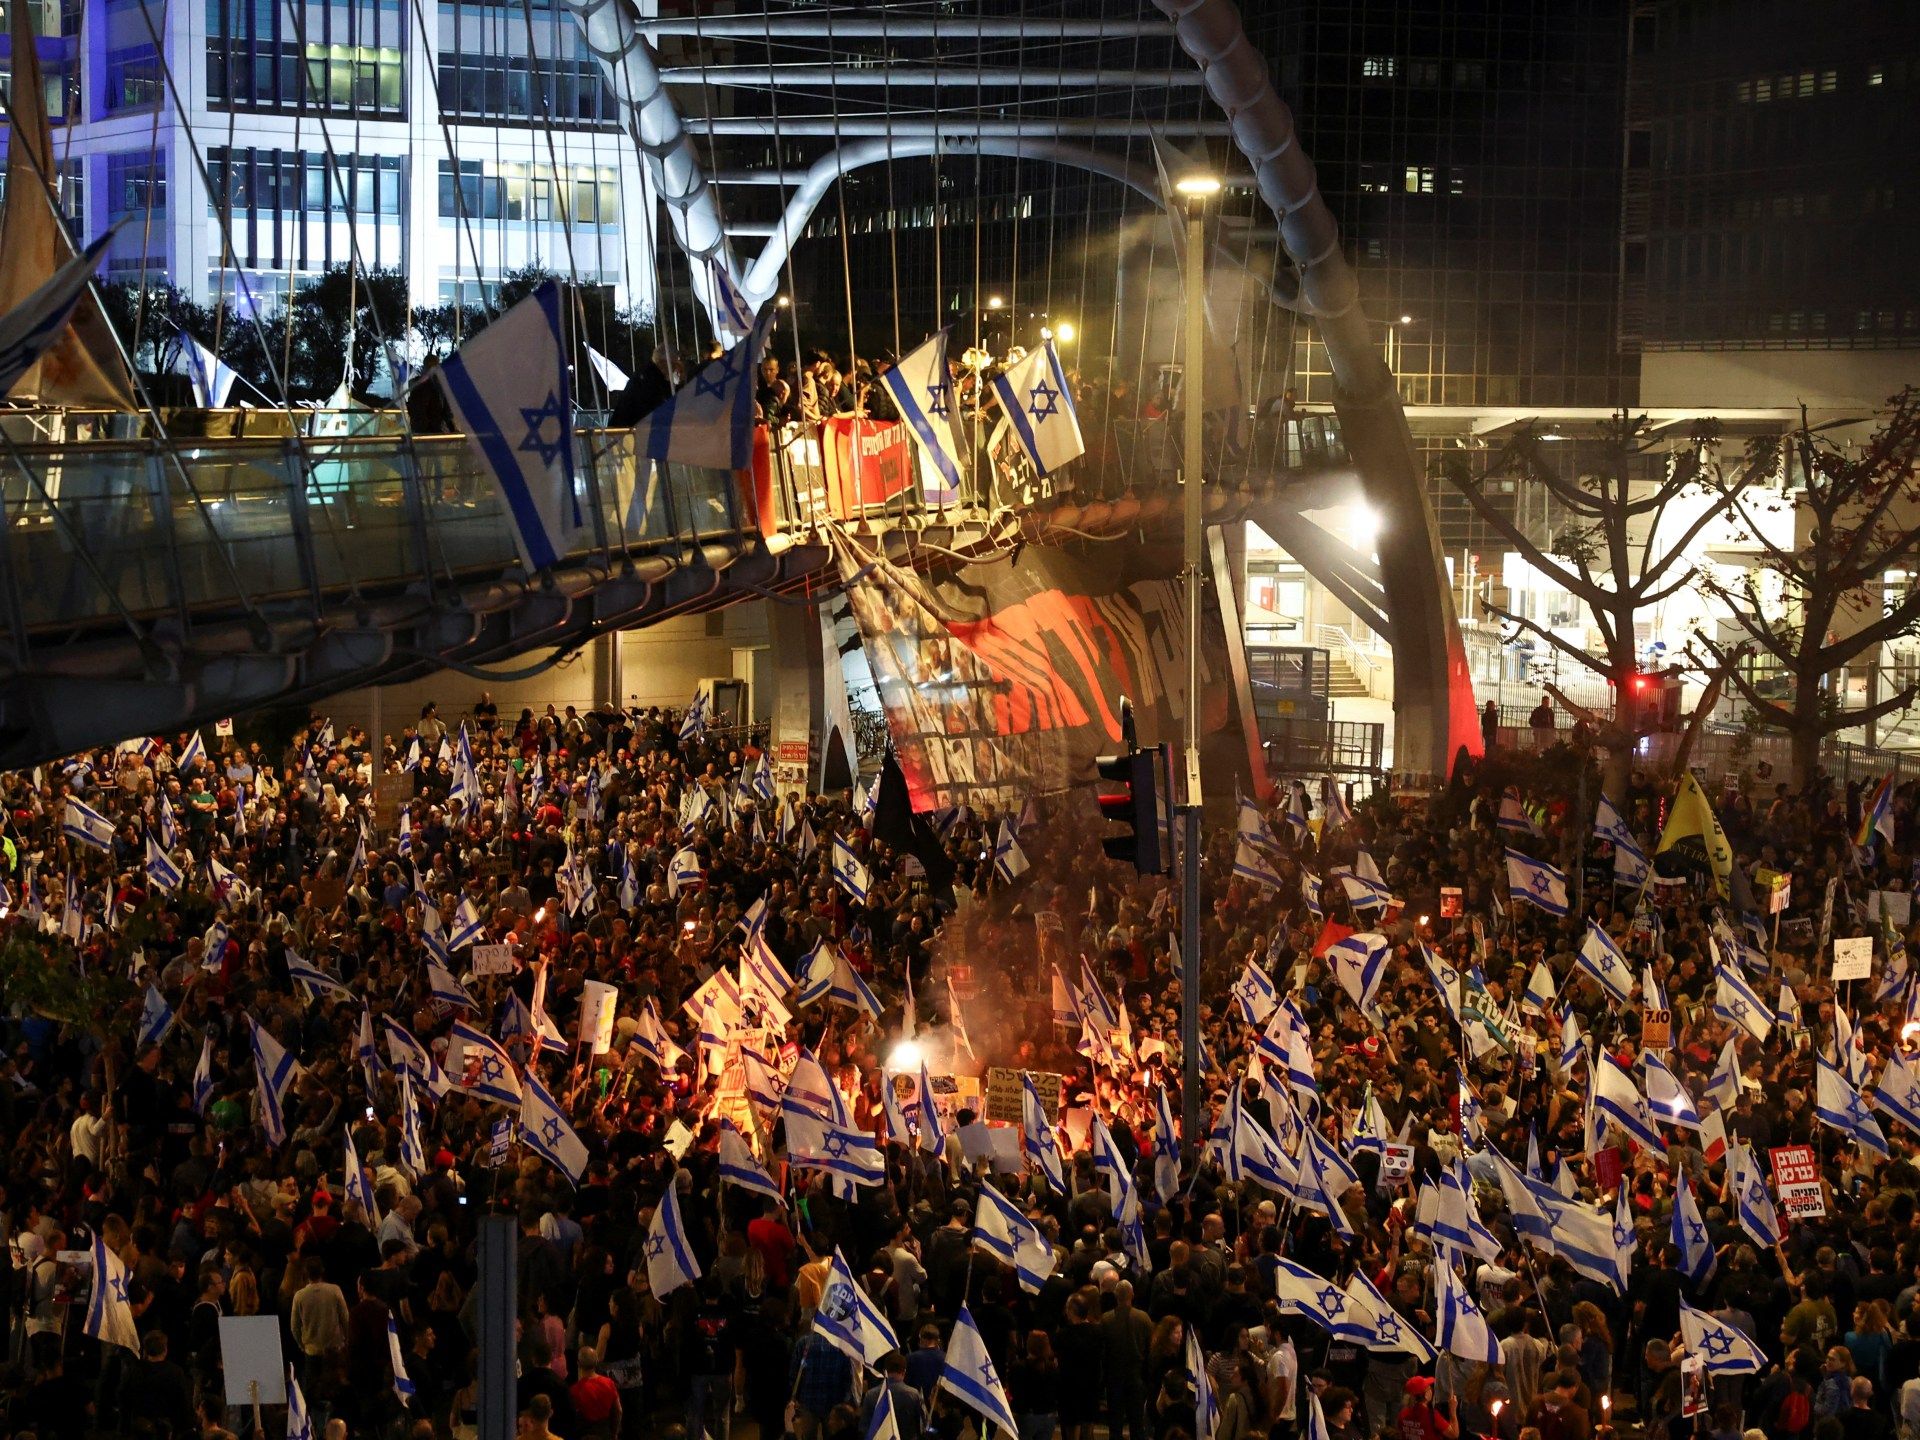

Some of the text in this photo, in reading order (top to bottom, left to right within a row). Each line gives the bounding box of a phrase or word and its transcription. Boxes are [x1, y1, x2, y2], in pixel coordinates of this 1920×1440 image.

[1645, 1010, 1670, 1024] 7.10
[1775, 1149, 1809, 1168] החורבן
[1777, 1165, 1814, 1185] כבר כאן
[1790, 1187, 1820, 1197] נתניהו
[1782, 1196, 1816, 1205] המכשול
[1791, 1201, 1822, 1213] לעסקה
